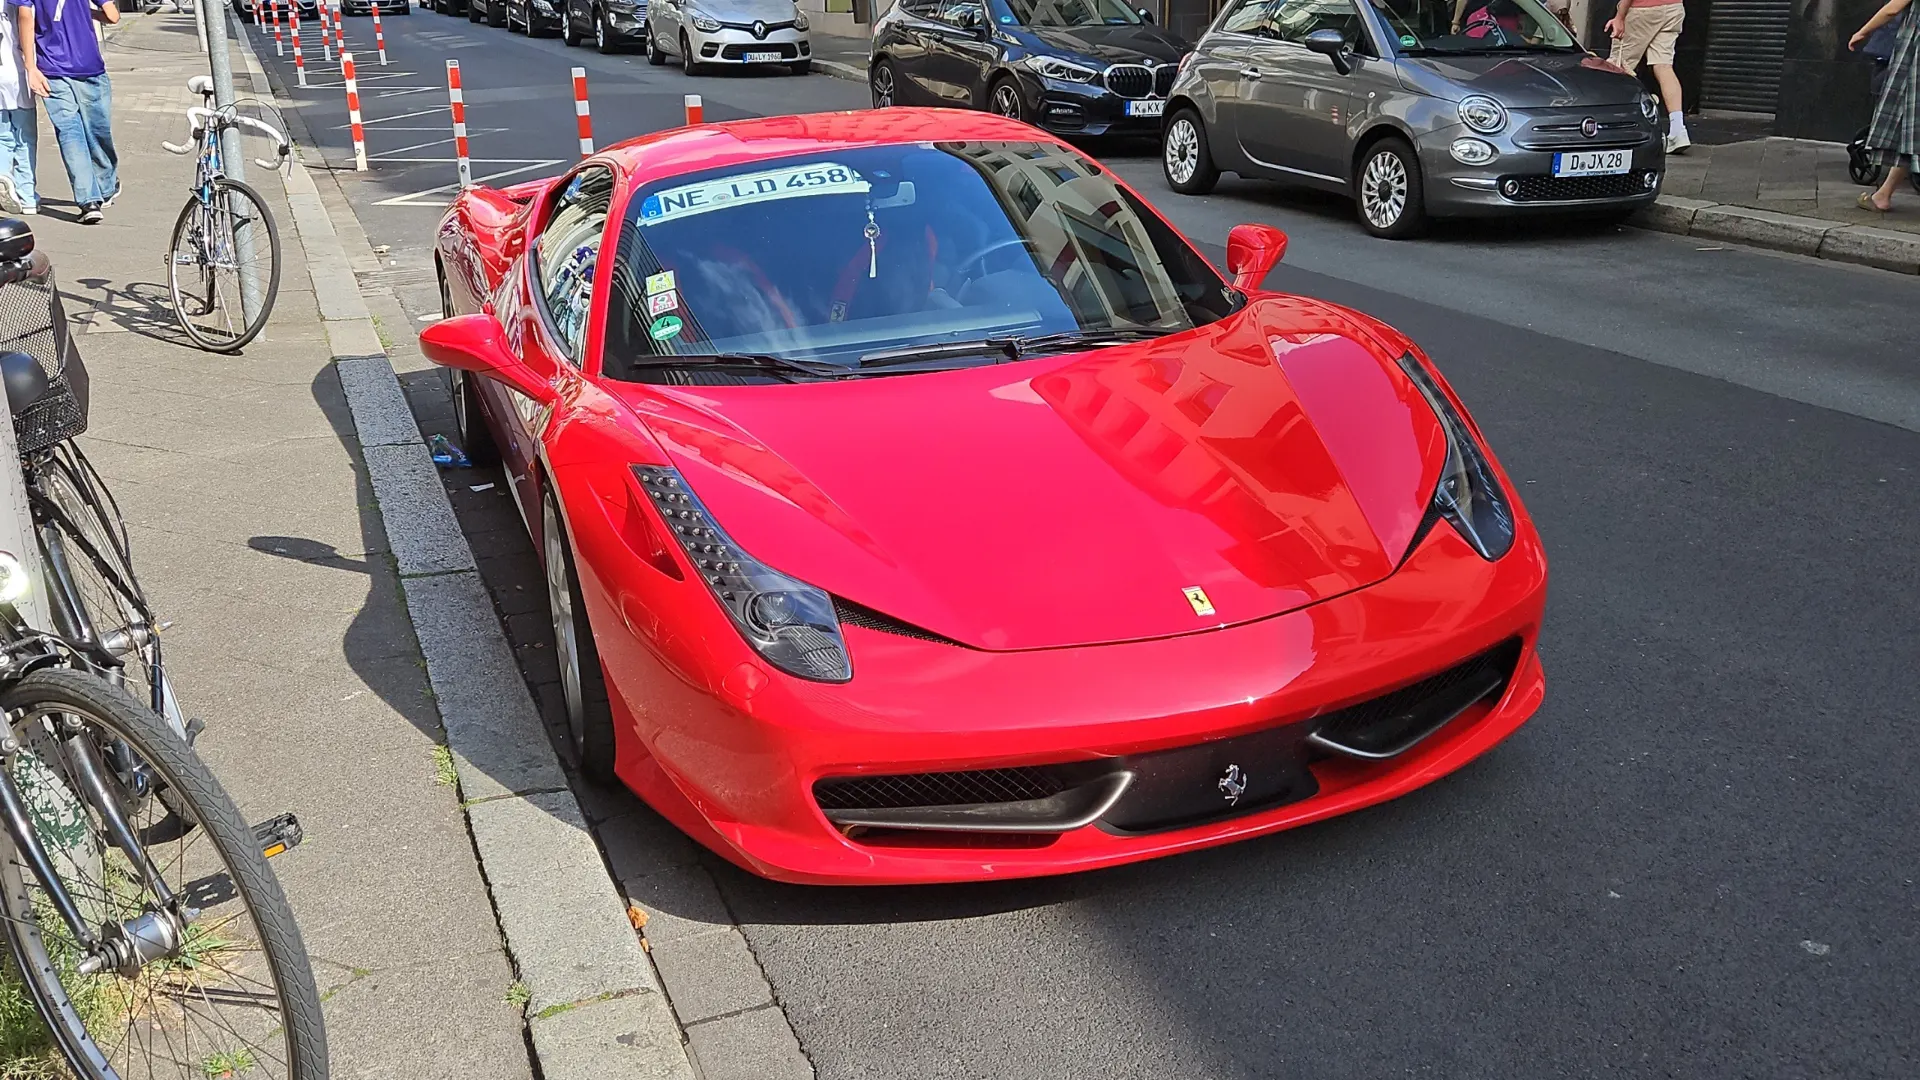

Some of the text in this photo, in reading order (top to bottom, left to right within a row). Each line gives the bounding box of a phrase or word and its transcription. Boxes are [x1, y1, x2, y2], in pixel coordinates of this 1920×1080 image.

[1135, 102, 1160, 113] K KX
[1570, 153, 1623, 170] D JX 28
[663, 168, 848, 212] NE LD 458
[661, 318, 671, 328] 4
